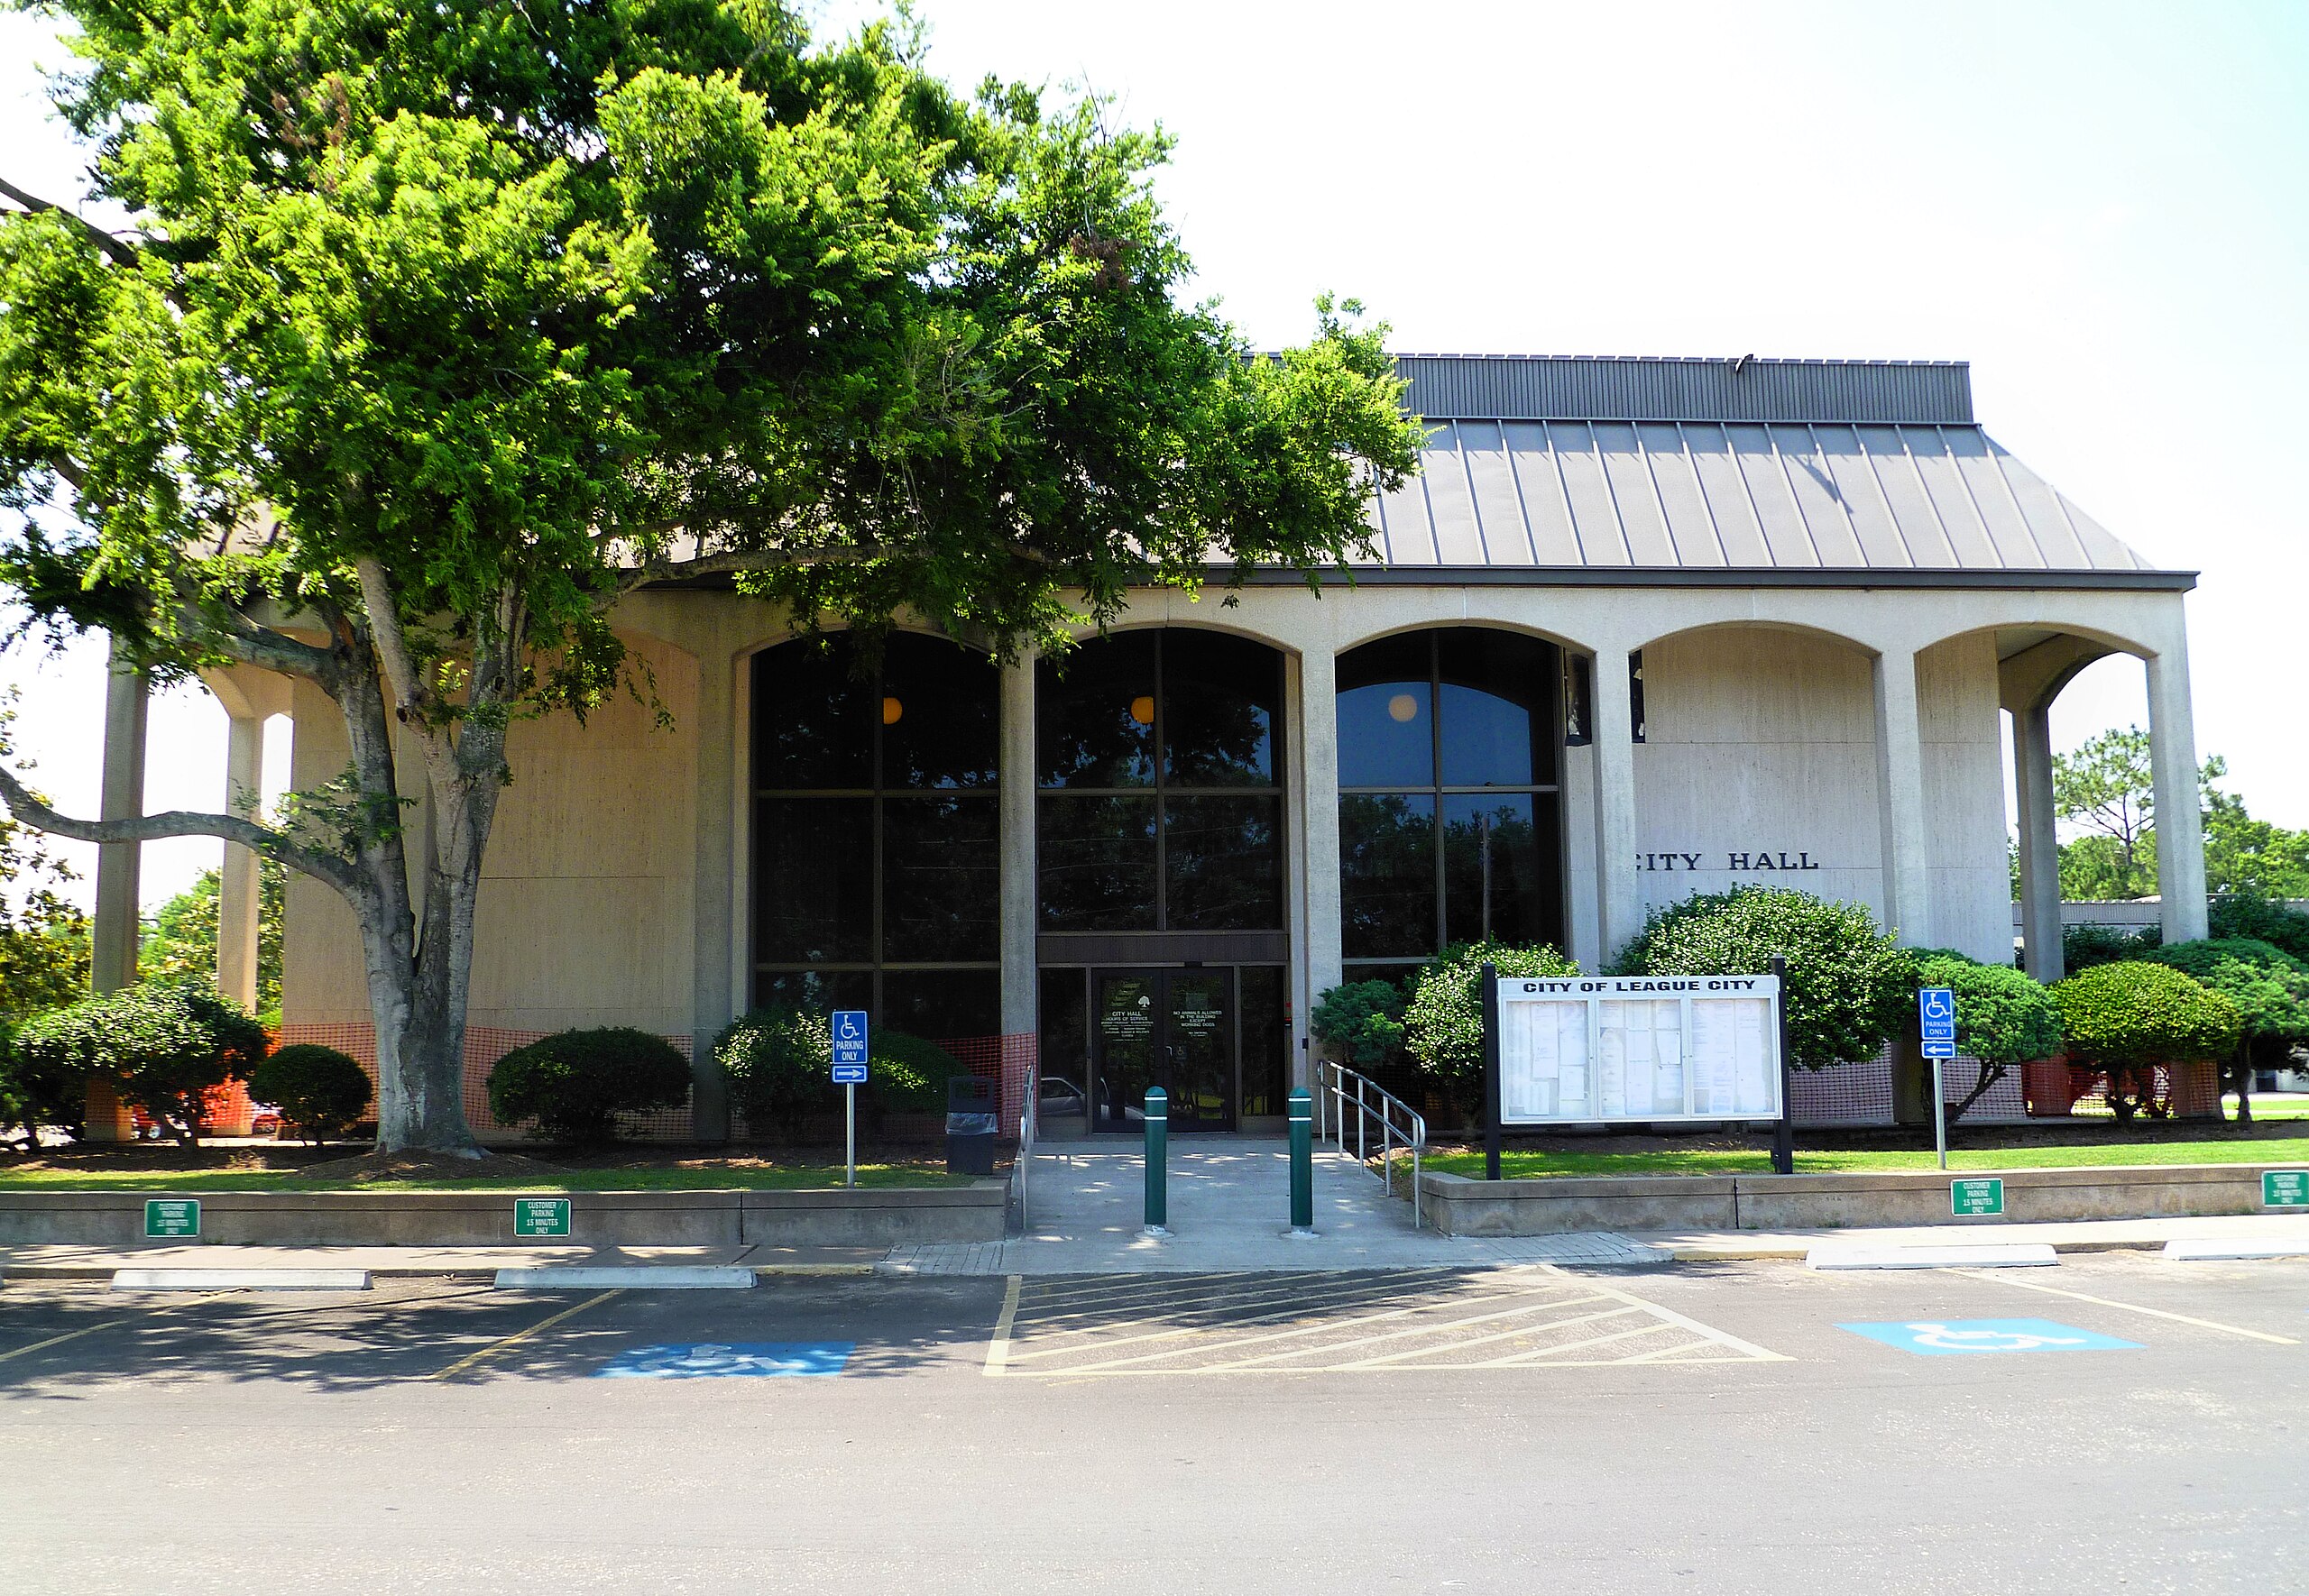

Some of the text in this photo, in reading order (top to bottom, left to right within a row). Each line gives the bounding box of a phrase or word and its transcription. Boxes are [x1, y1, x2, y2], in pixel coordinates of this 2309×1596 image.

[1728, 852, 1818, 870] HALL
[1522, 979, 1755, 993] CITY OF LEAGUE CITY
[835, 1040, 864, 1050] PARKING
[842, 1051, 858, 1060] ONLY
[1963, 1181, 1991, 1189] CUSTOMER
[528, 1201, 557, 1209] CUSTOMER
[1963, 1197, 1993, 1206] 15 MINUTES
[531, 1209, 555, 1217] PARKING
[1972, 1206, 1984, 1214] ONLY
[526, 1218, 558, 1226] 15 MINUTES
[535, 1226, 549, 1234] ONLY
